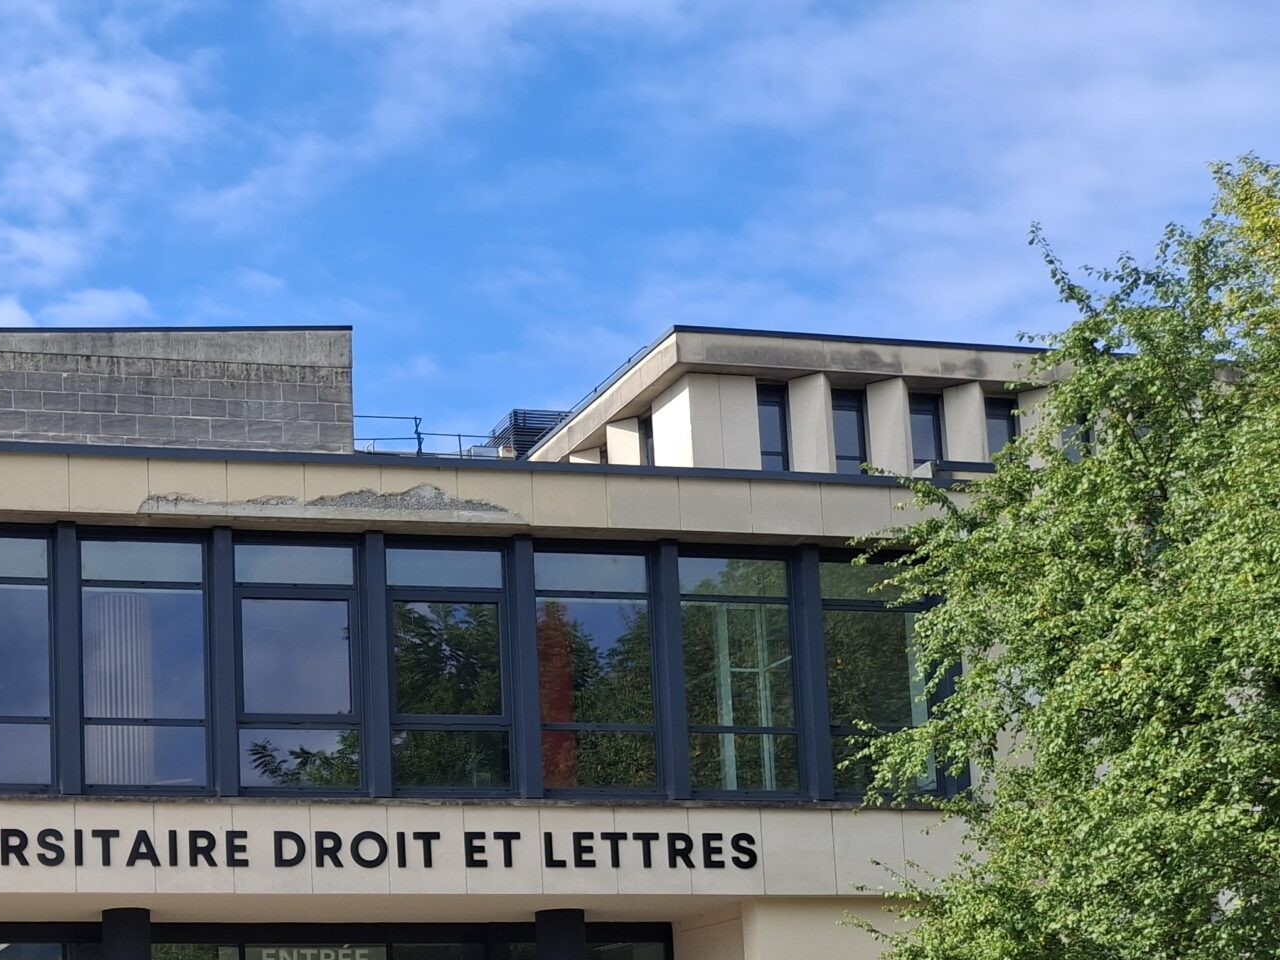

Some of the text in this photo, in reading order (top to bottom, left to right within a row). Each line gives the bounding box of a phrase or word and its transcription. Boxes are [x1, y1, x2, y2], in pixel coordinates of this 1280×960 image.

[273, 830, 441, 869] DROIT
[464, 831, 521, 868] ET
[543, 831, 758, 870] LETTRES
